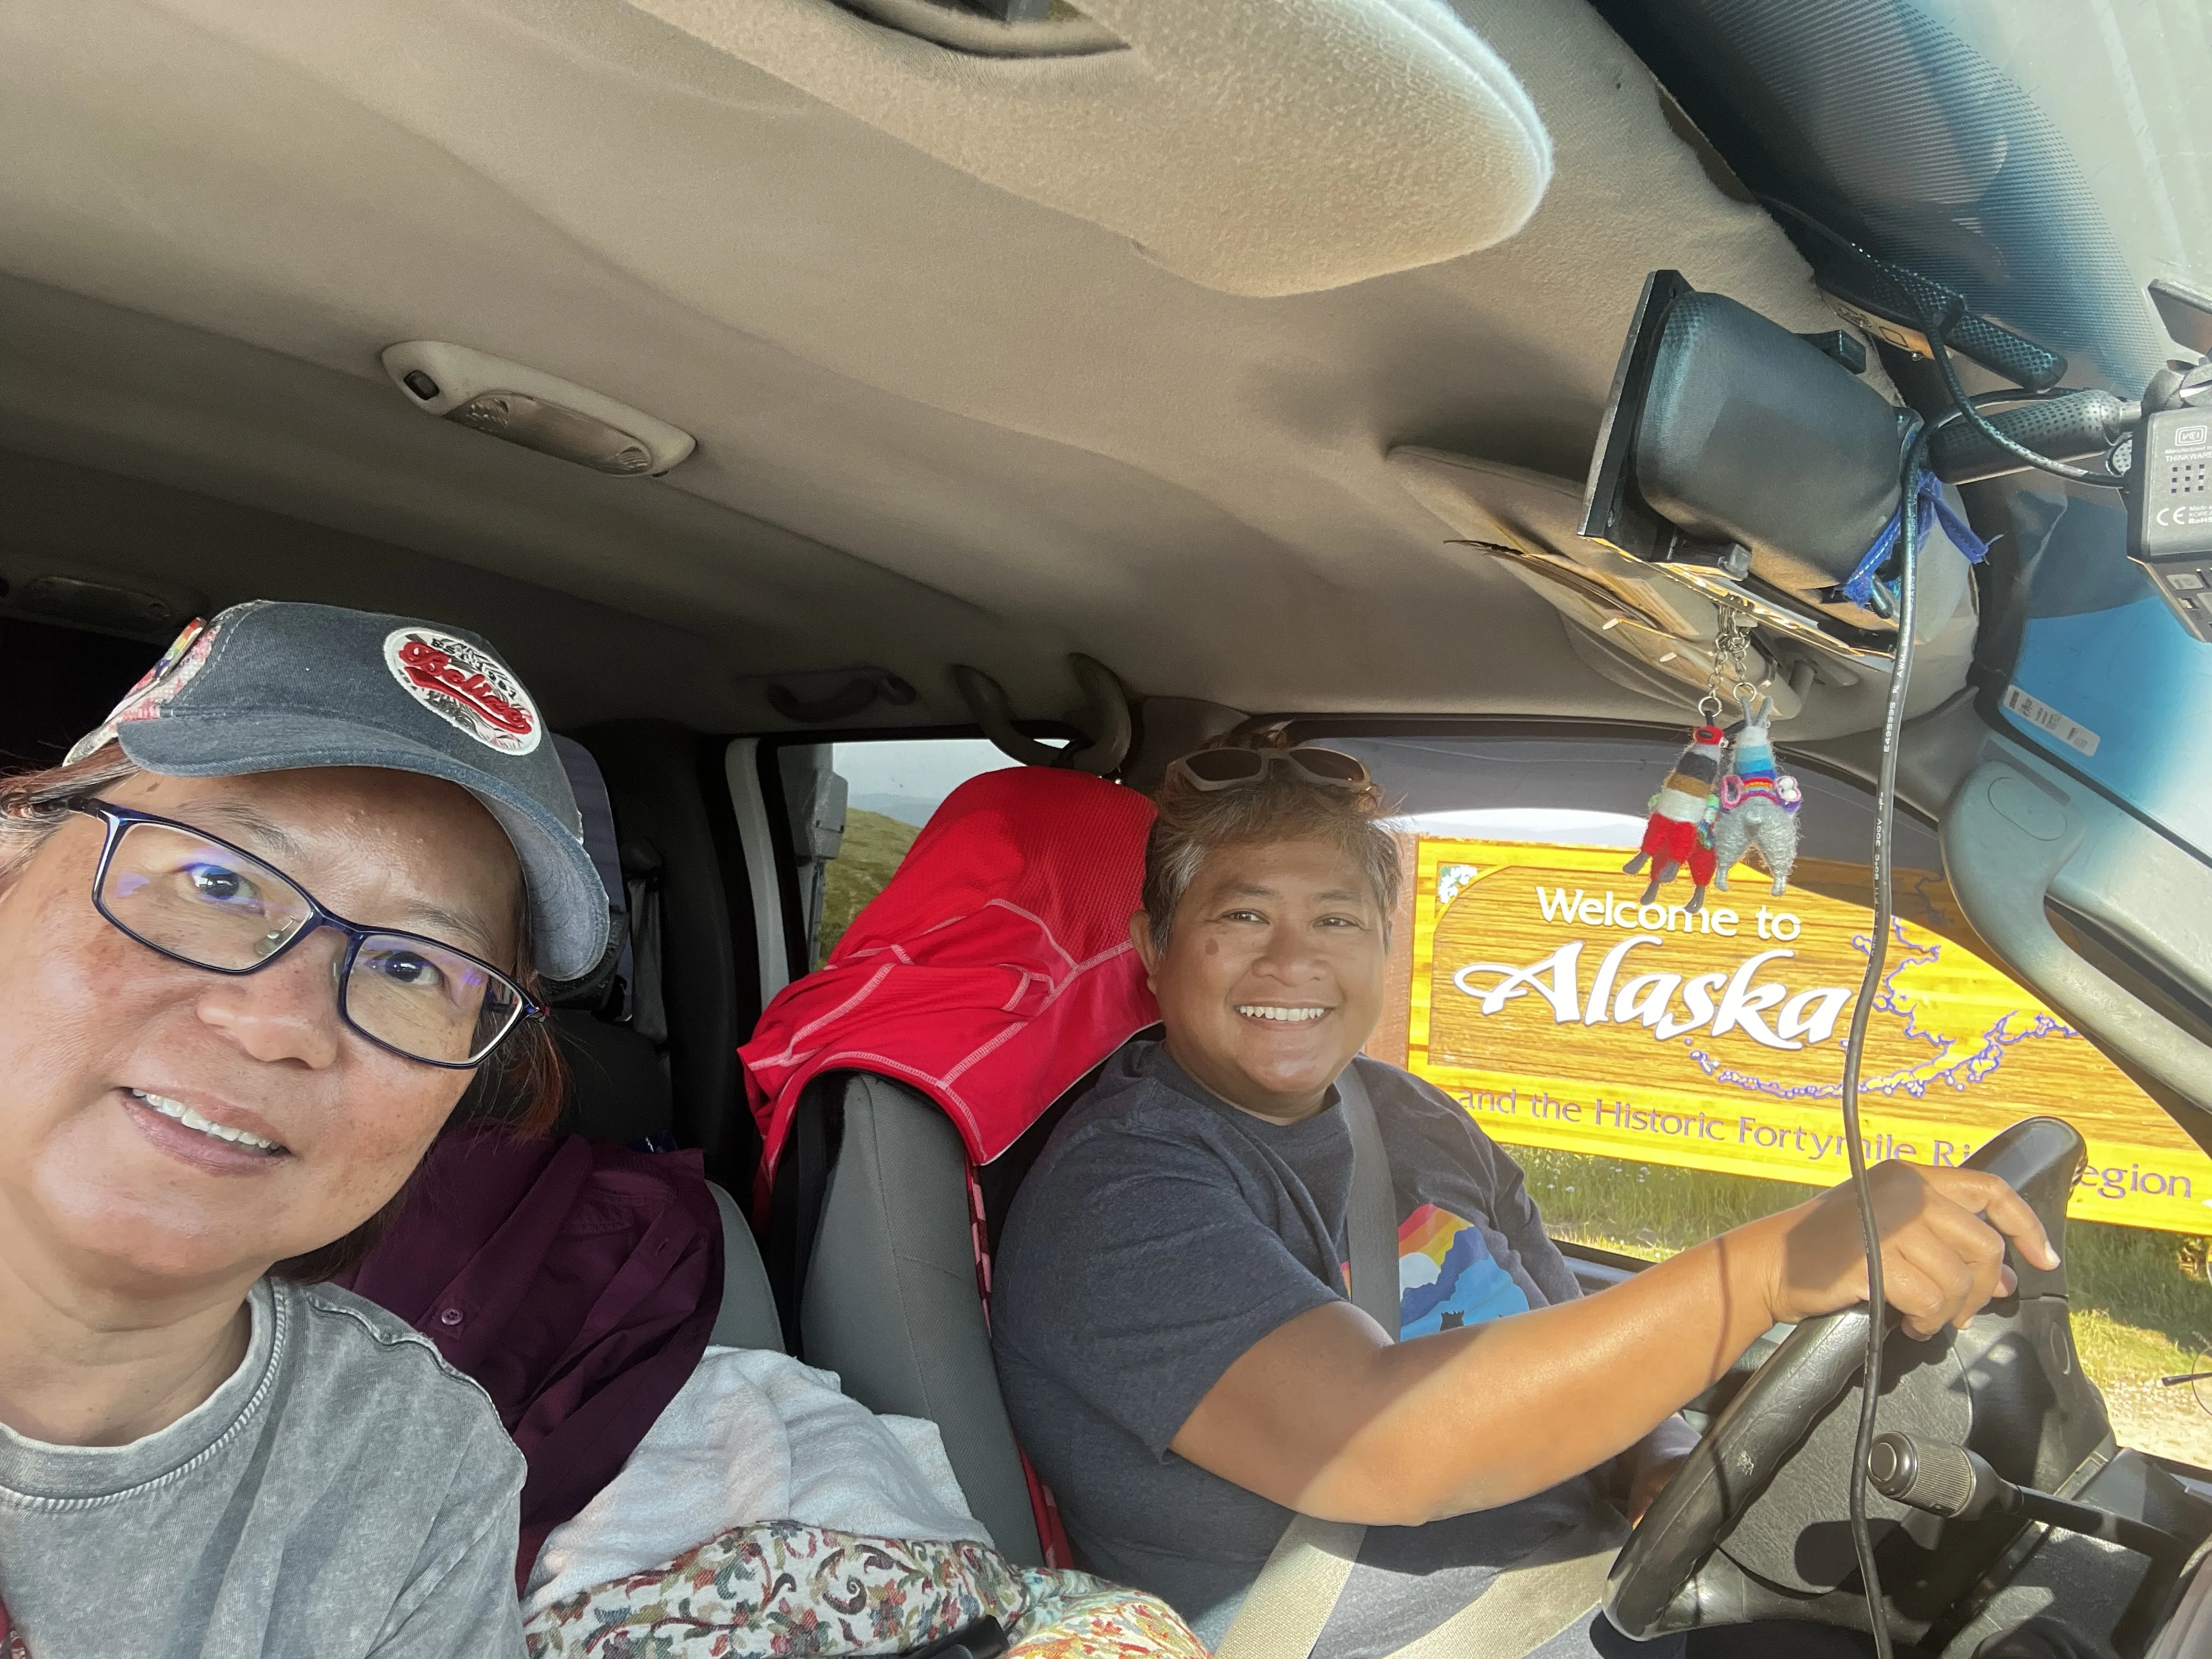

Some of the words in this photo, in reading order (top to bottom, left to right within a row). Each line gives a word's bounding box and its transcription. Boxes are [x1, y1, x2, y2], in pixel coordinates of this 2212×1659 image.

[2165, 451, 2212, 462] THINKWARE
[2157, 506, 2186, 526] CE
[399, 641, 532, 734] Belize
[1874, 818, 1882, 846] 300V
[1896, 653, 1906, 678] AWM
[1536, 886, 1739, 936] Welcome
[1755, 904, 1802, 941] to
[1453, 935, 1852, 1050] Alaska
[1457, 1088, 1517, 1115] and
[1531, 1092, 1582, 1122] the
[1595, 1098, 1725, 1141] Historic
[2079, 1163, 2192, 1200] egion
